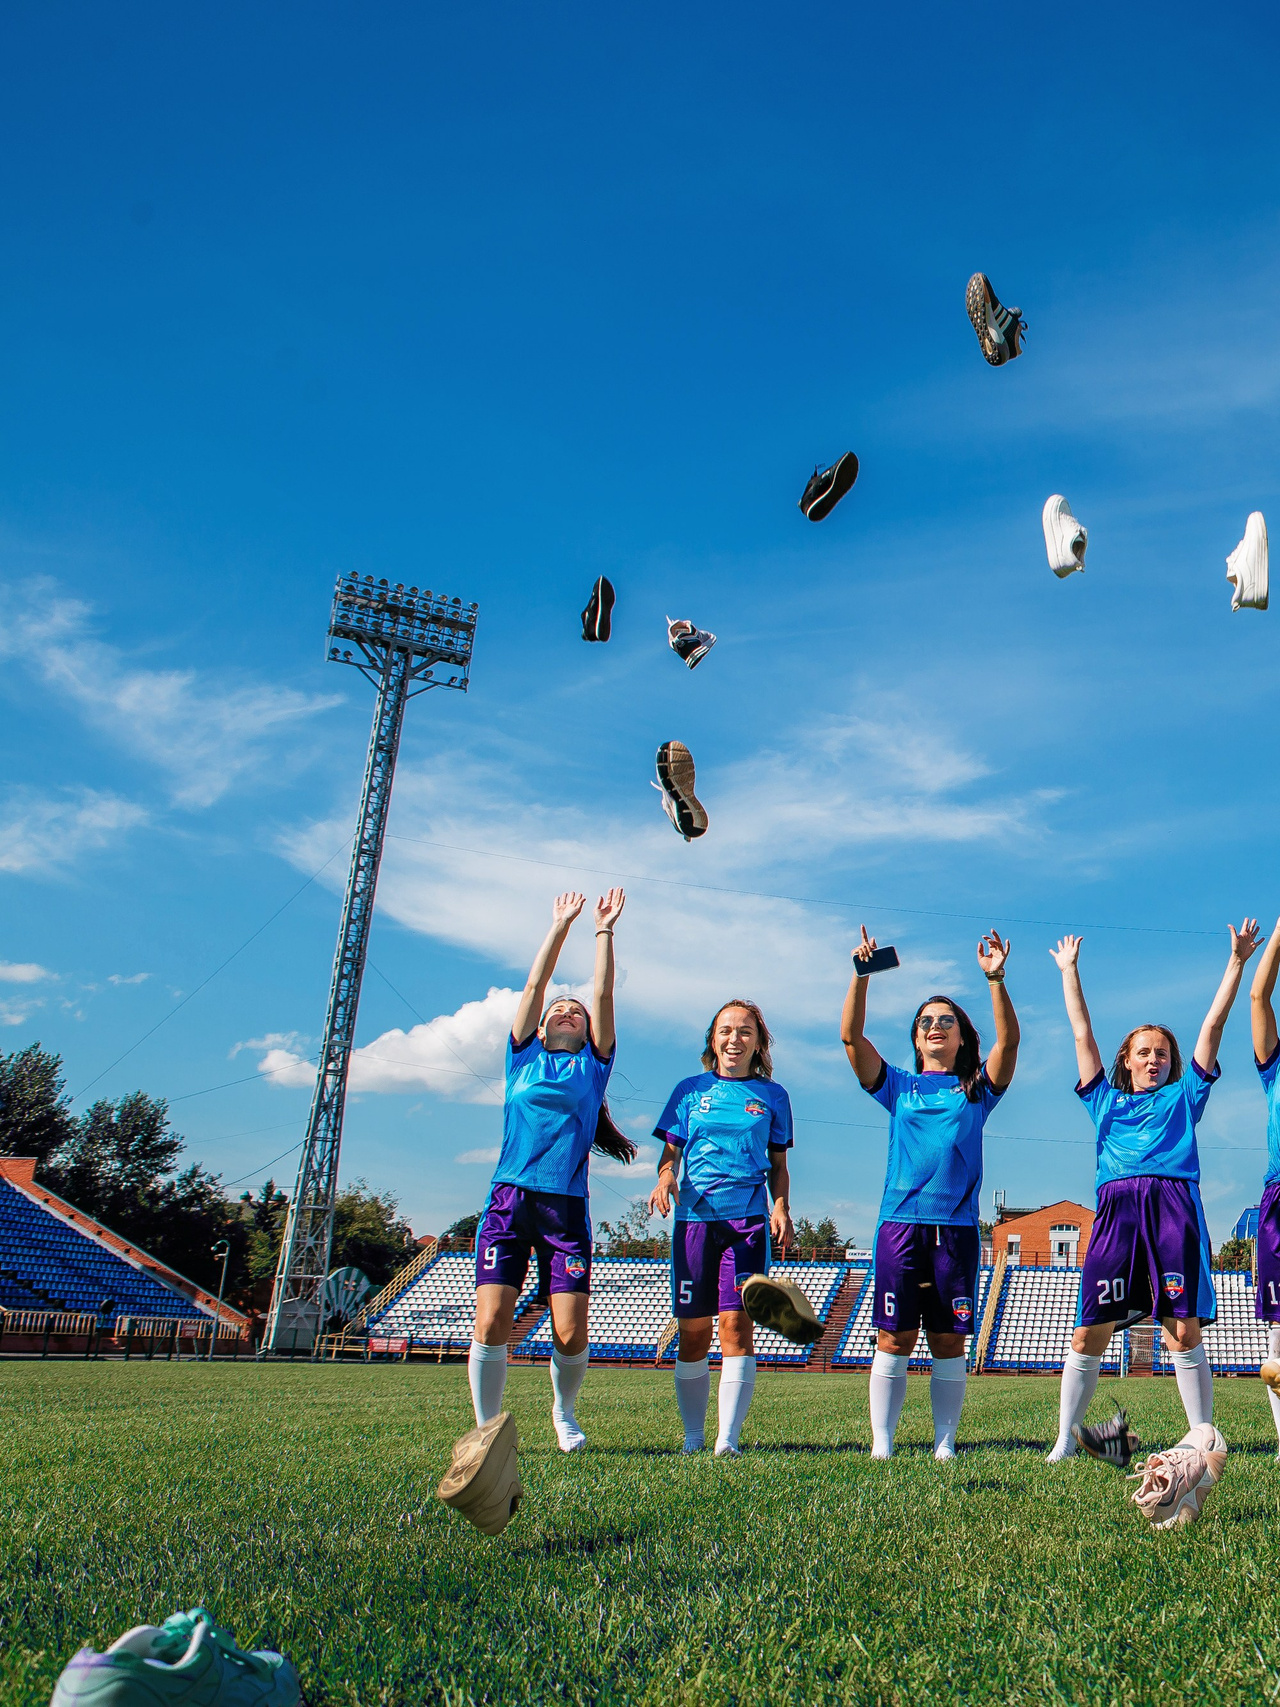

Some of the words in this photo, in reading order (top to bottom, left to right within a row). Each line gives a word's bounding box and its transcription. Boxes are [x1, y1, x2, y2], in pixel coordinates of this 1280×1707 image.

[699, 1096, 712, 1113] 5
[483, 1246, 498, 1270] 9
[679, 1280, 693, 1304] 5
[1097, 1278, 1125, 1305] 20
[884, 1292, 896, 1317] 6
